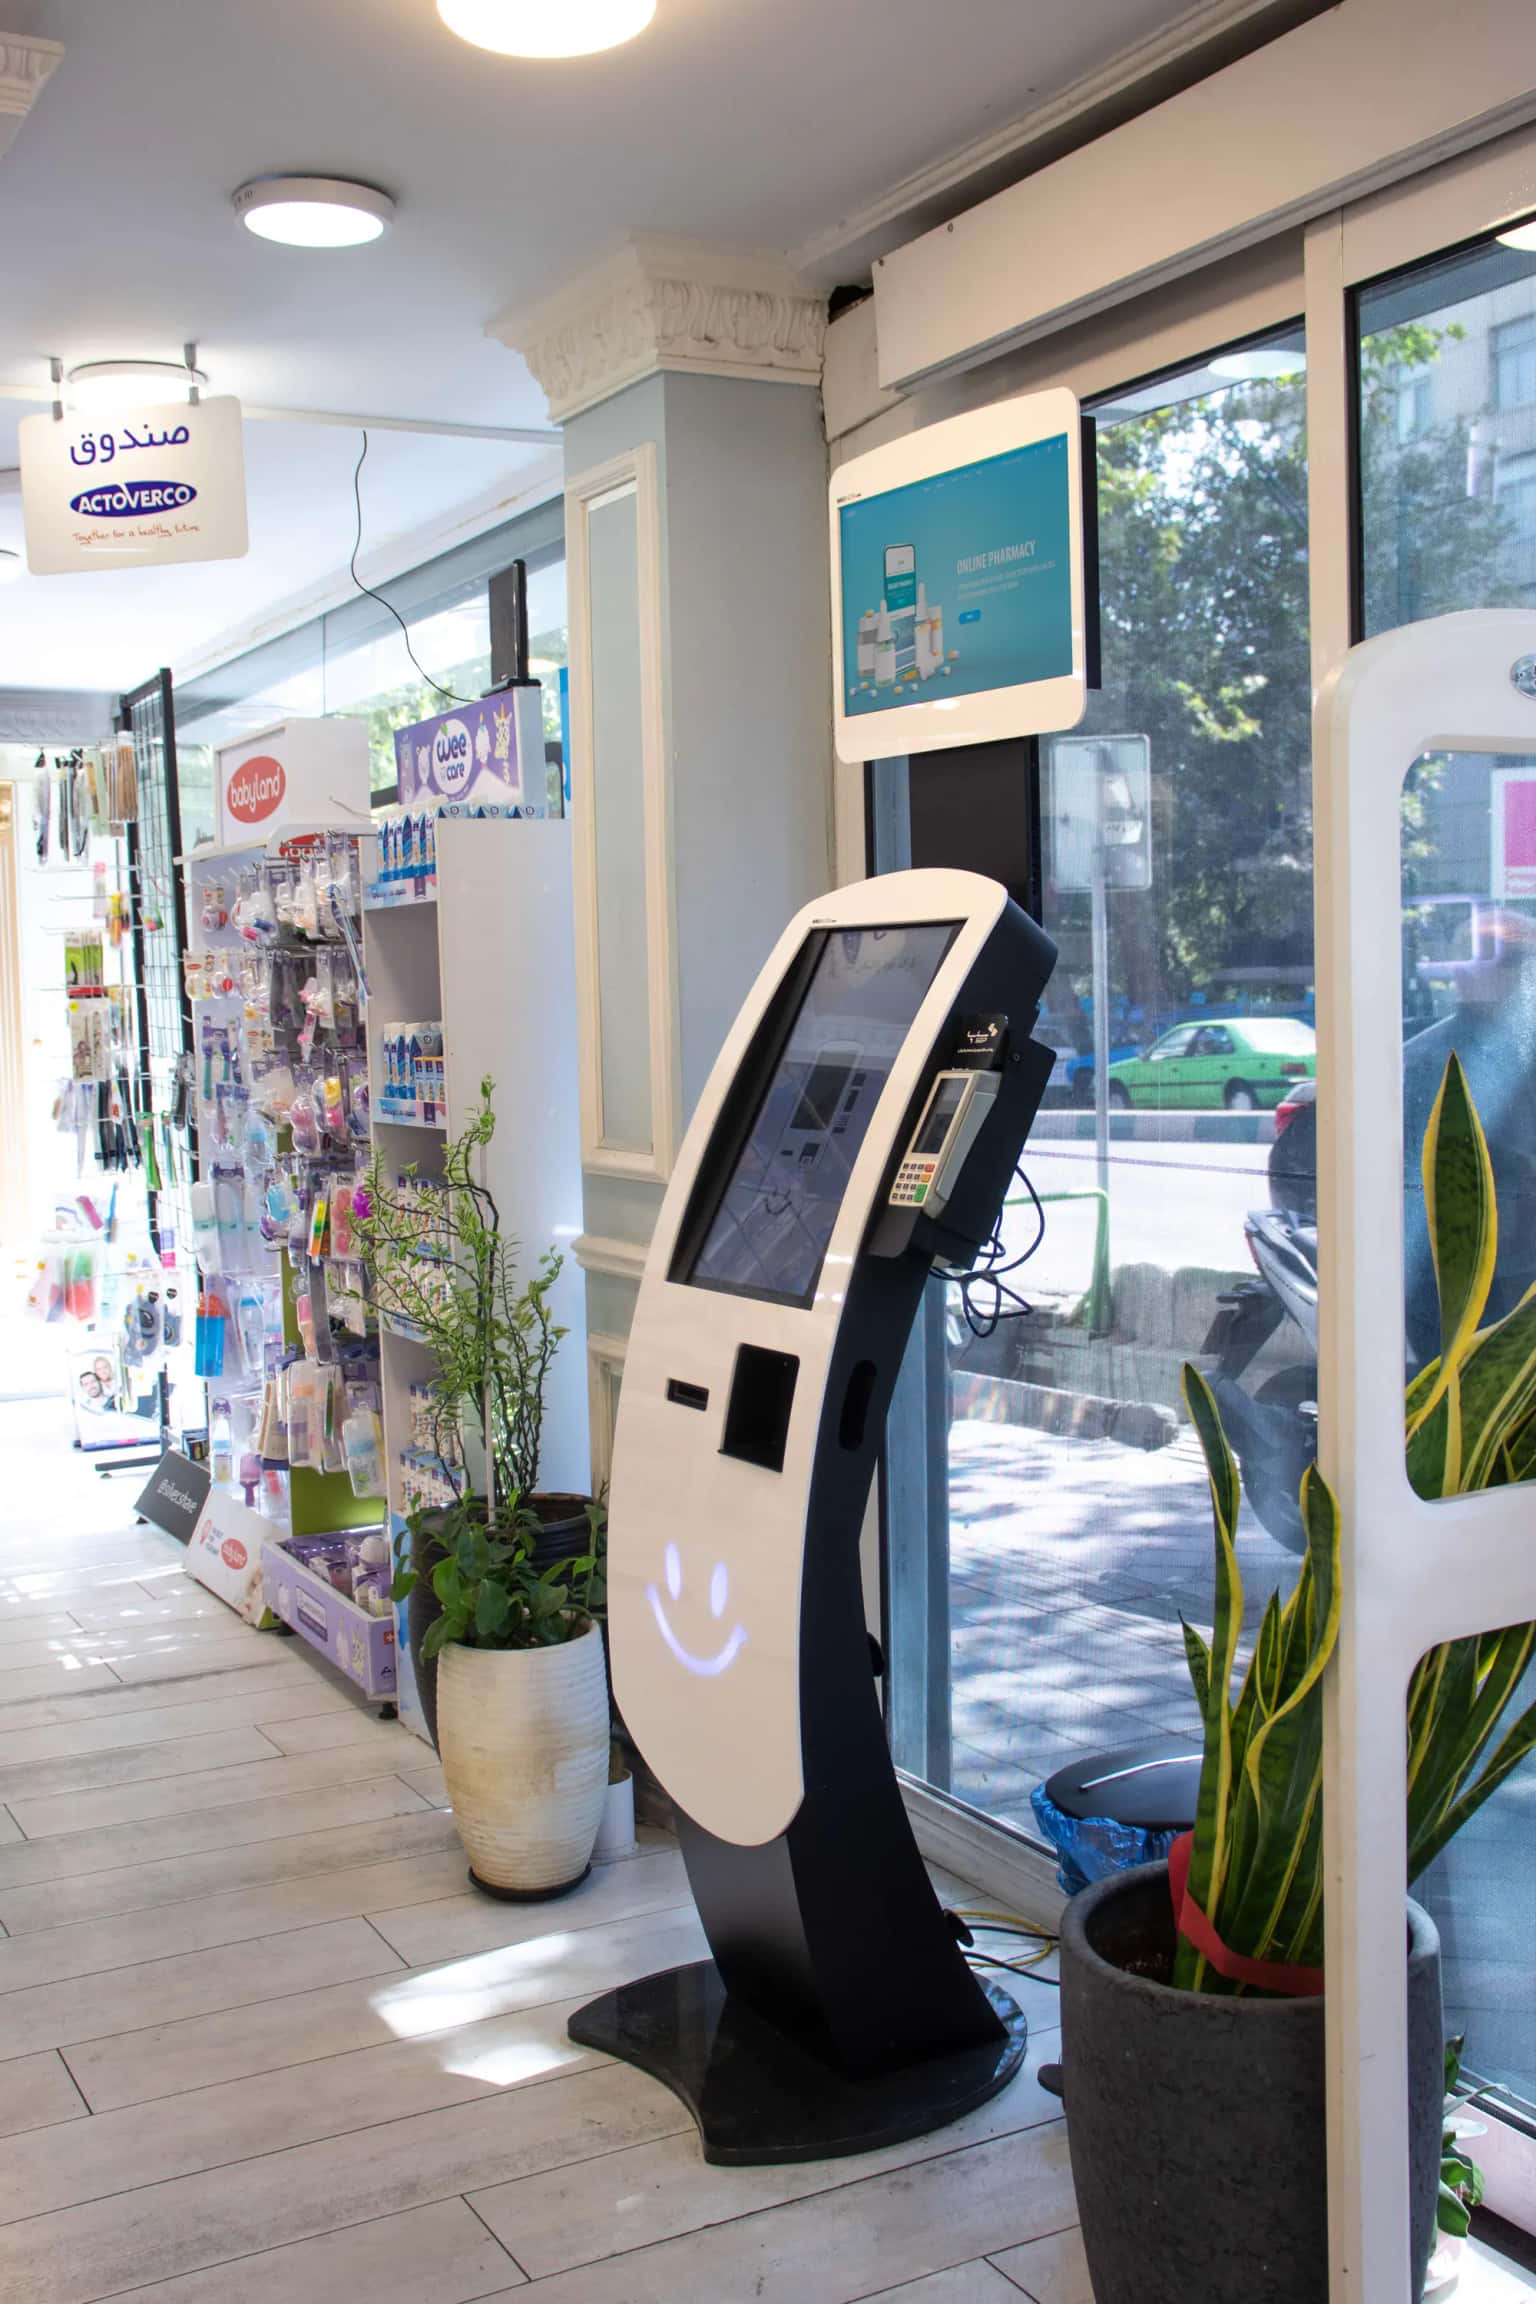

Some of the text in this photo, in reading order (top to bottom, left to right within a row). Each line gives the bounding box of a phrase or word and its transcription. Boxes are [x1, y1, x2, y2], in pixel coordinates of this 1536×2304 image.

[70, 424, 189, 465] صندوق
[79, 483, 191, 512] ACTOVERCO
[956, 552, 986, 576] ONLINE
[987, 540, 1036, 566] PHARMACY
[446, 761, 465, 781] care
[231, 766, 281, 814] babyland
